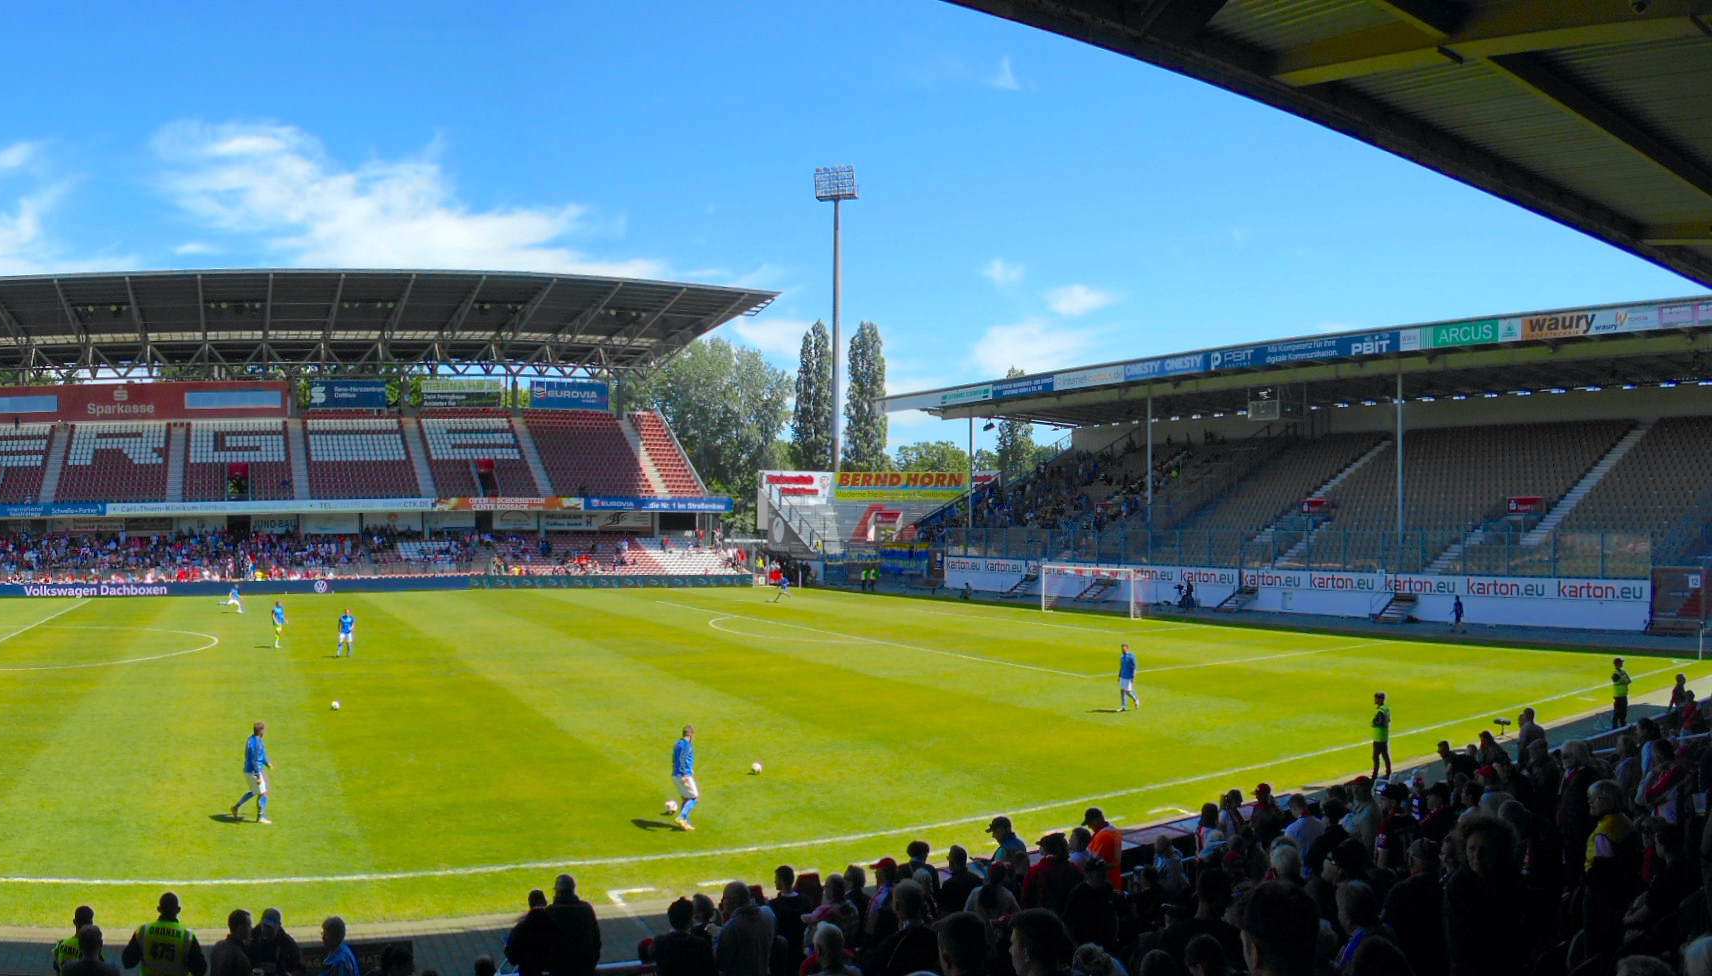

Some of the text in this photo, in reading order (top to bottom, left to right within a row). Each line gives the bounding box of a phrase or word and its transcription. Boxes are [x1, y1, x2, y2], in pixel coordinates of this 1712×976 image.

[1528, 312, 1596, 333] waury
[1594, 323, 1619, 332] waury
[1438, 324, 1493, 344] ARCUS
[1277, 342, 1313, 354] Kompetenz
[1313, 341, 1324, 350] für
[1351, 335, 1390, 356] PBIT
[1164, 355, 1203, 371] ONESTY
[1223, 349, 1255, 362] PBIT
[1265, 354, 1288, 365] digitale
[1125, 360, 1161, 376] ONESTY
[547, 389, 598, 399] EUROVIA
[87, 402, 155, 416] Sparkasse
[839, 472, 904, 487] BERND
[908, 472, 965, 487] HORN
[600, 500, 634, 508] EUROVIA
[661, 501, 672, 510] Nr.
[677, 501, 687, 510] im
[687, 502, 726, 511] Straßenbau
[253, 519, 297, 529] JUNO-BAU
[946, 558, 981, 571] karton.eu
[984, 560, 1023, 574] karton.eu
[1180, 567, 1235, 585] karton.eu
[1241, 569, 1302, 588] karton.eu
[1308, 572, 1376, 591] karton.eu
[23, 583, 168, 599] Volkswagen Dachboxen
[1385, 575, 1457, 594] karton.eu
[1466, 577, 1546, 598] karton.eu
[1557, 580, 1644, 600] karton.eu
[149, 925, 181, 939] ORDNER
